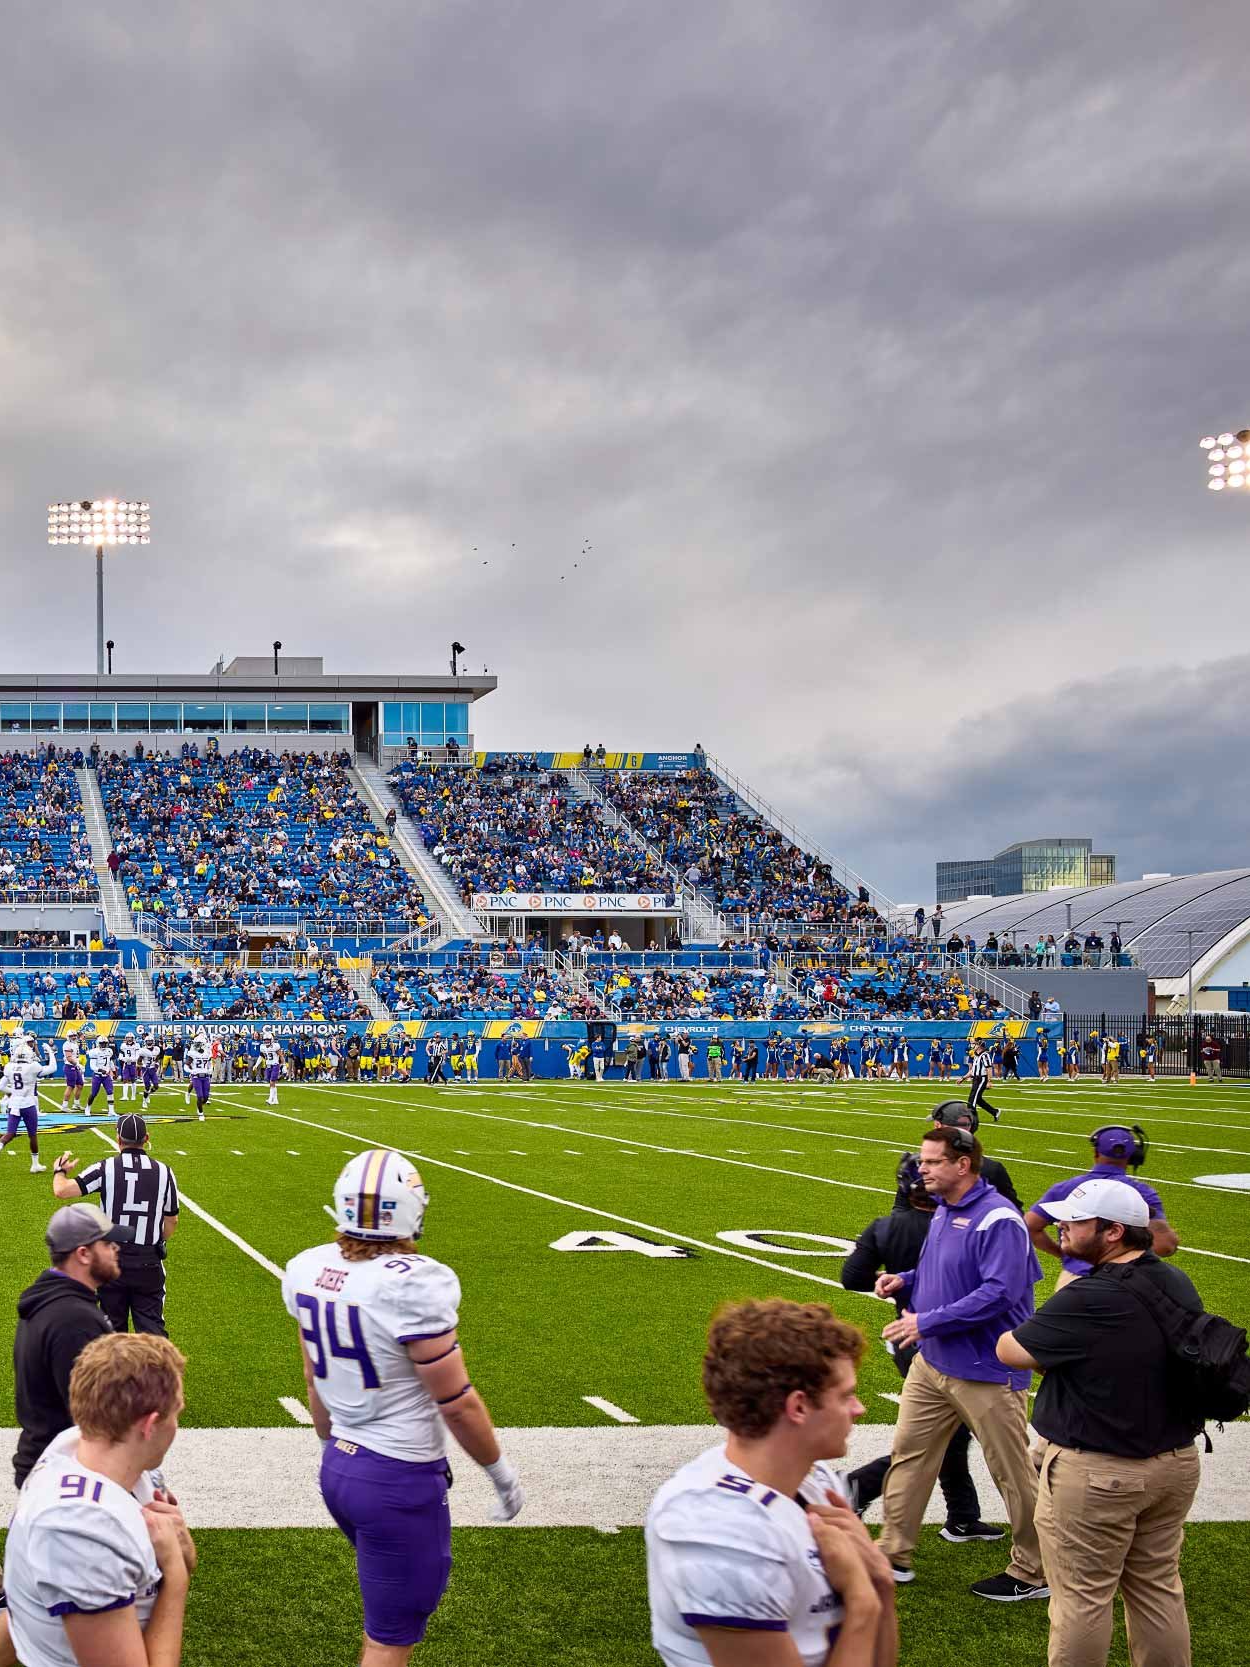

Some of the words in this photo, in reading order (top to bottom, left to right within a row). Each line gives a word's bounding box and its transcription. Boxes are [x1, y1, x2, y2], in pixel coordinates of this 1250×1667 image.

[490, 896, 518, 907] PNC
[544, 896, 572, 907] PNC
[598, 896, 626, 907] PNC
[136, 1024, 145, 1035] 6
[148, 1024, 182, 1035] TIME
[186, 1024, 255, 1034] NATIONAL
[262, 1024, 347, 1034] CHAMPIONS
[196, 1059, 208, 1069] 27
[13, 1072, 24, 1090] 8
[123, 1172, 150, 1213] L
[295, 1292, 382, 1391] 94
[60, 1474, 104, 1502] 91
